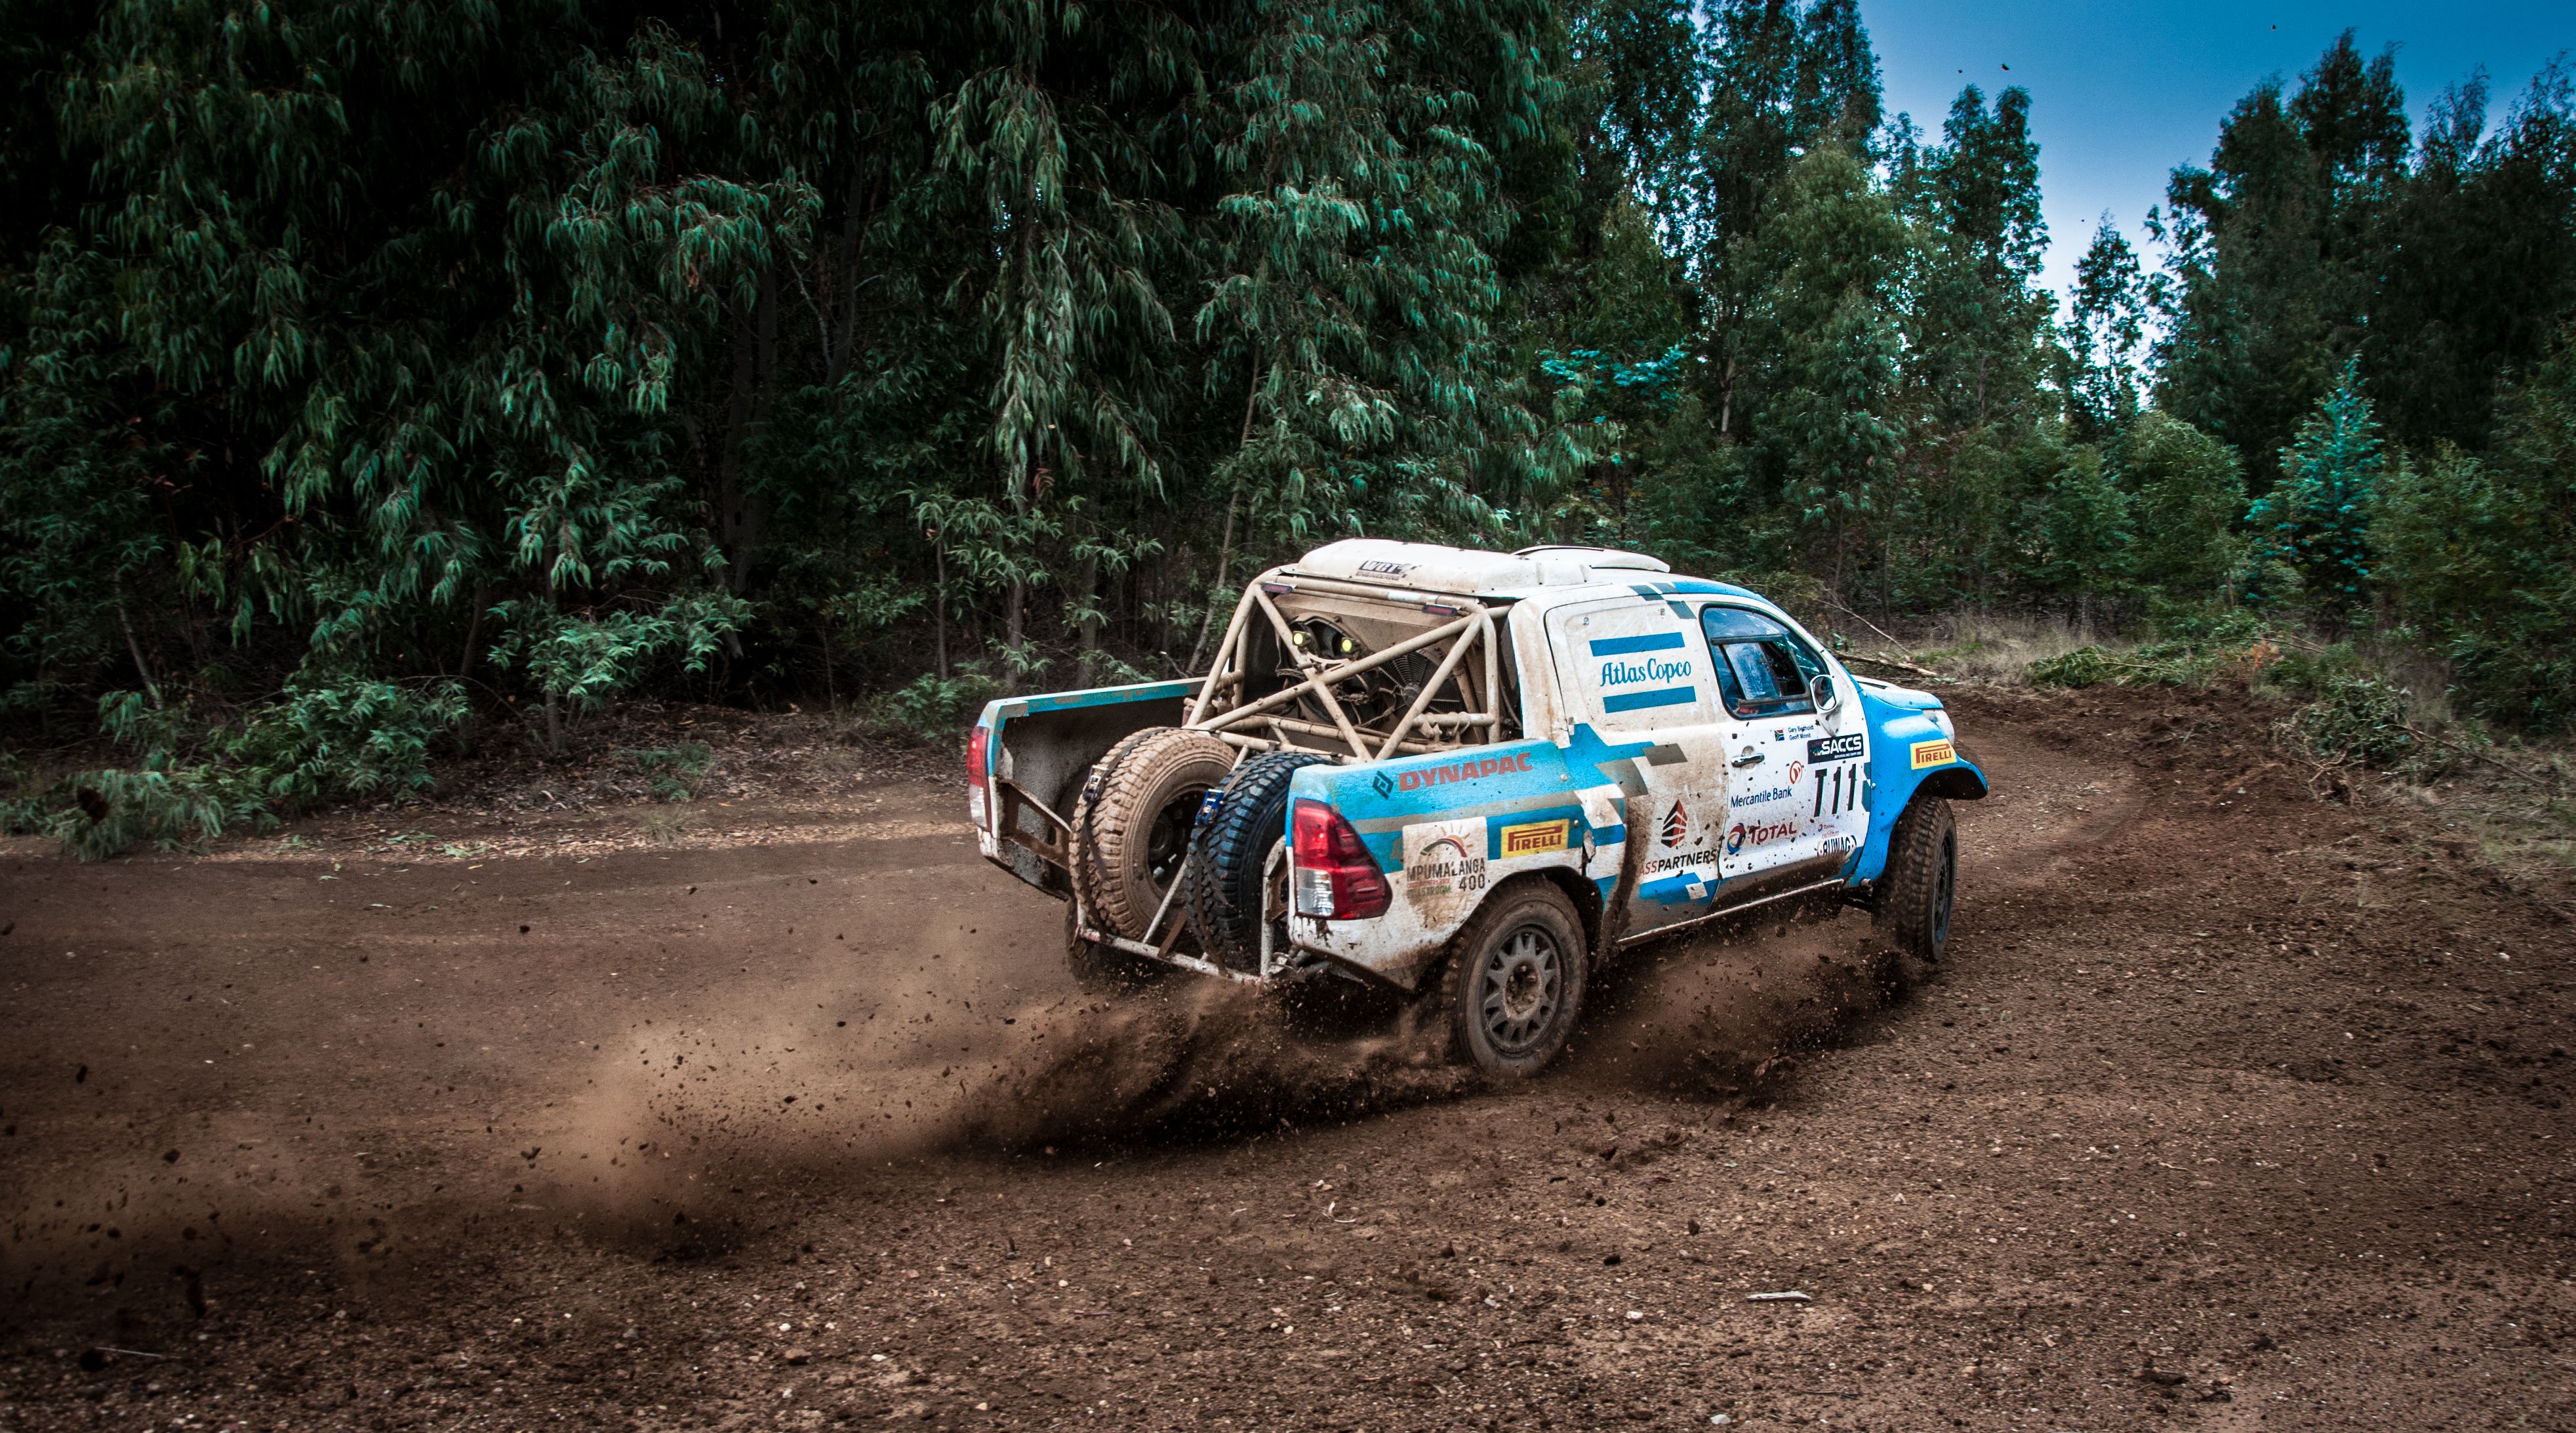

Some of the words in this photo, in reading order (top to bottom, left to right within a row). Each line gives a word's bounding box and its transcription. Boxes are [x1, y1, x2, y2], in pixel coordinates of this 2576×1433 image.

[1600, 662, 1646, 687] Atlas
[1647, 658, 1691, 683] Copco
[1820, 736, 1861, 755] SACCS
[1915, 743, 1952, 763] PIRELLI
[1399, 752, 1533, 792] DYNAPAC
[1731, 789, 1771, 808] Mercantile
[1773, 787, 1792, 800] Bank
[1814, 763, 1855, 817] T11
[1508, 825, 1563, 852] PIRELLI
[1748, 822, 1797, 844] TOTAL
[1407, 857, 1485, 881] MPUMALANGA
[1459, 874, 1485, 891] 400
